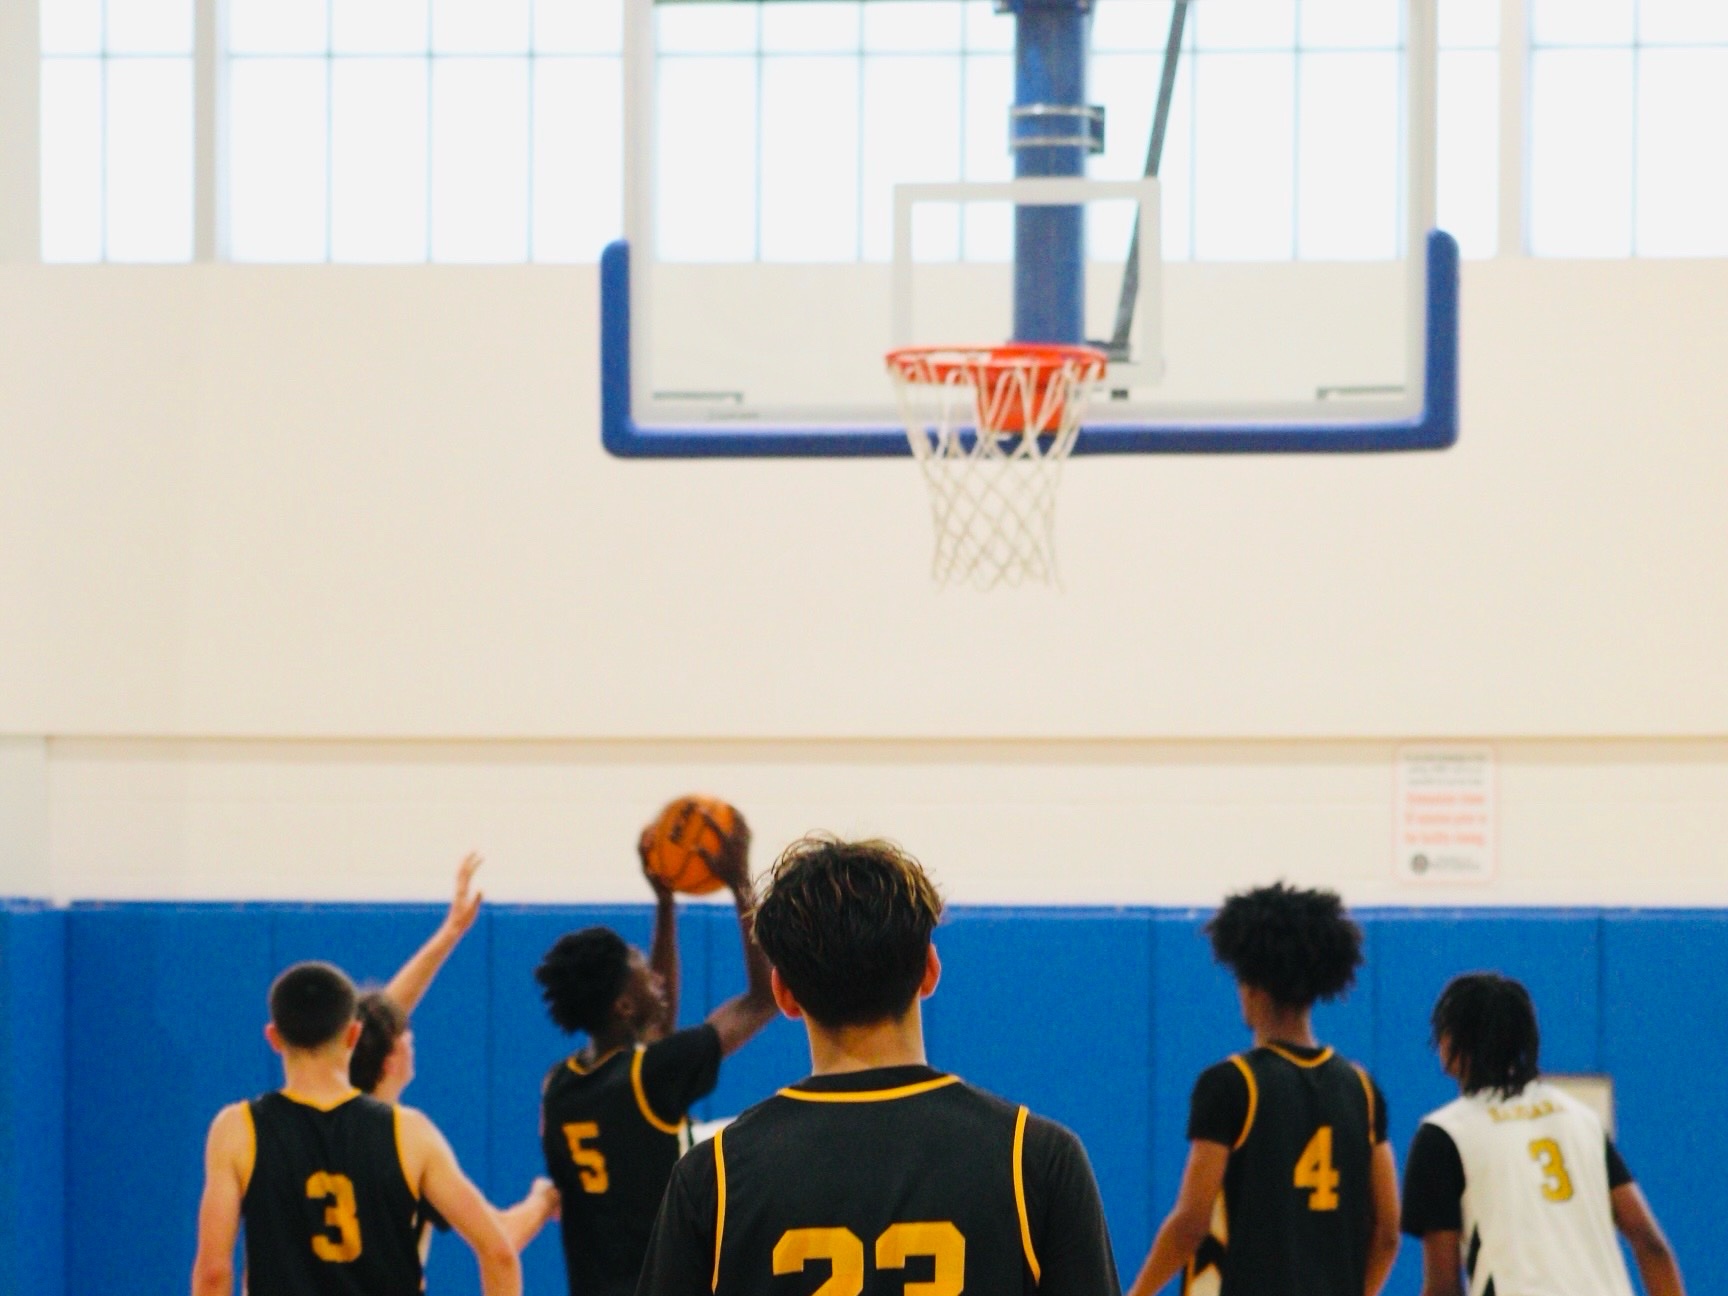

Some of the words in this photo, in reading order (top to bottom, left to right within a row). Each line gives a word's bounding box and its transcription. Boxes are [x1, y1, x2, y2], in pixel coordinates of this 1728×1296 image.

[562, 1121, 609, 1191] 5
[1293, 1126, 1340, 1211] 4
[1528, 1137, 1575, 1202] 3
[305, 1170, 362, 1263] 3
